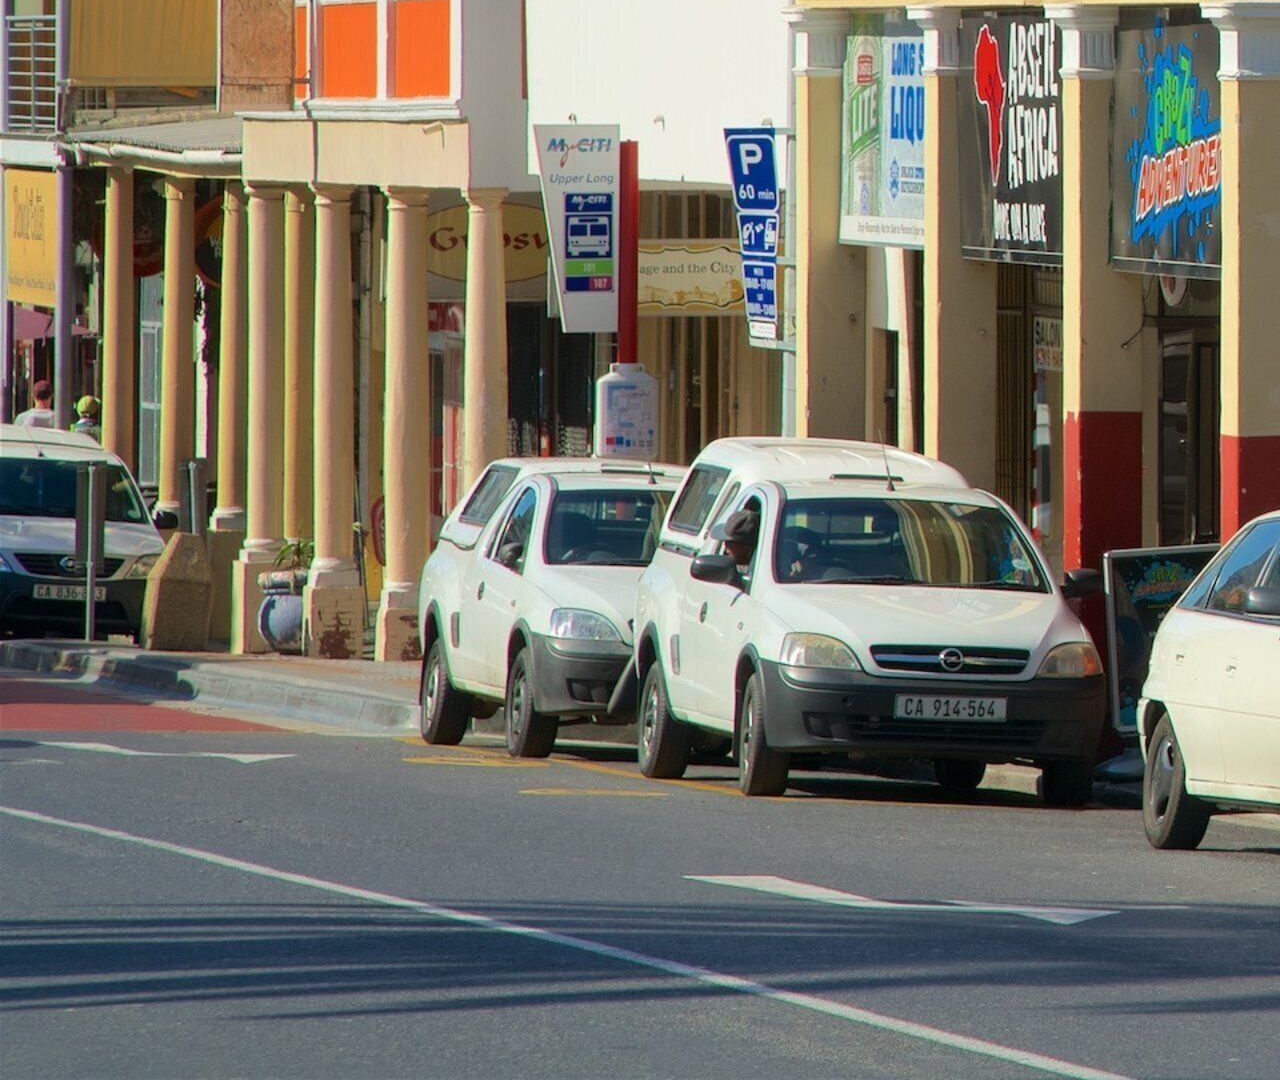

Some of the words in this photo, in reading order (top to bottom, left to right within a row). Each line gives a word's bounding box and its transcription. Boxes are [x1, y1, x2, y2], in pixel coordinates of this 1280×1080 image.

[891, 43, 915, 75] LONG
[1008, 19, 1058, 105] ABSEIL
[739, 143, 763, 175] P
[1008, 103, 1059, 190] AFRICA
[550, 174, 584, 185] Upper
[587, 173, 614, 185] Long
[739, 184, 755, 200] 60
[758, 188, 775, 200] min
[662, 263, 685, 274] and
[688, 263, 707, 274] the
[711, 261, 737, 274] City
[904, 698, 923, 717] CA
